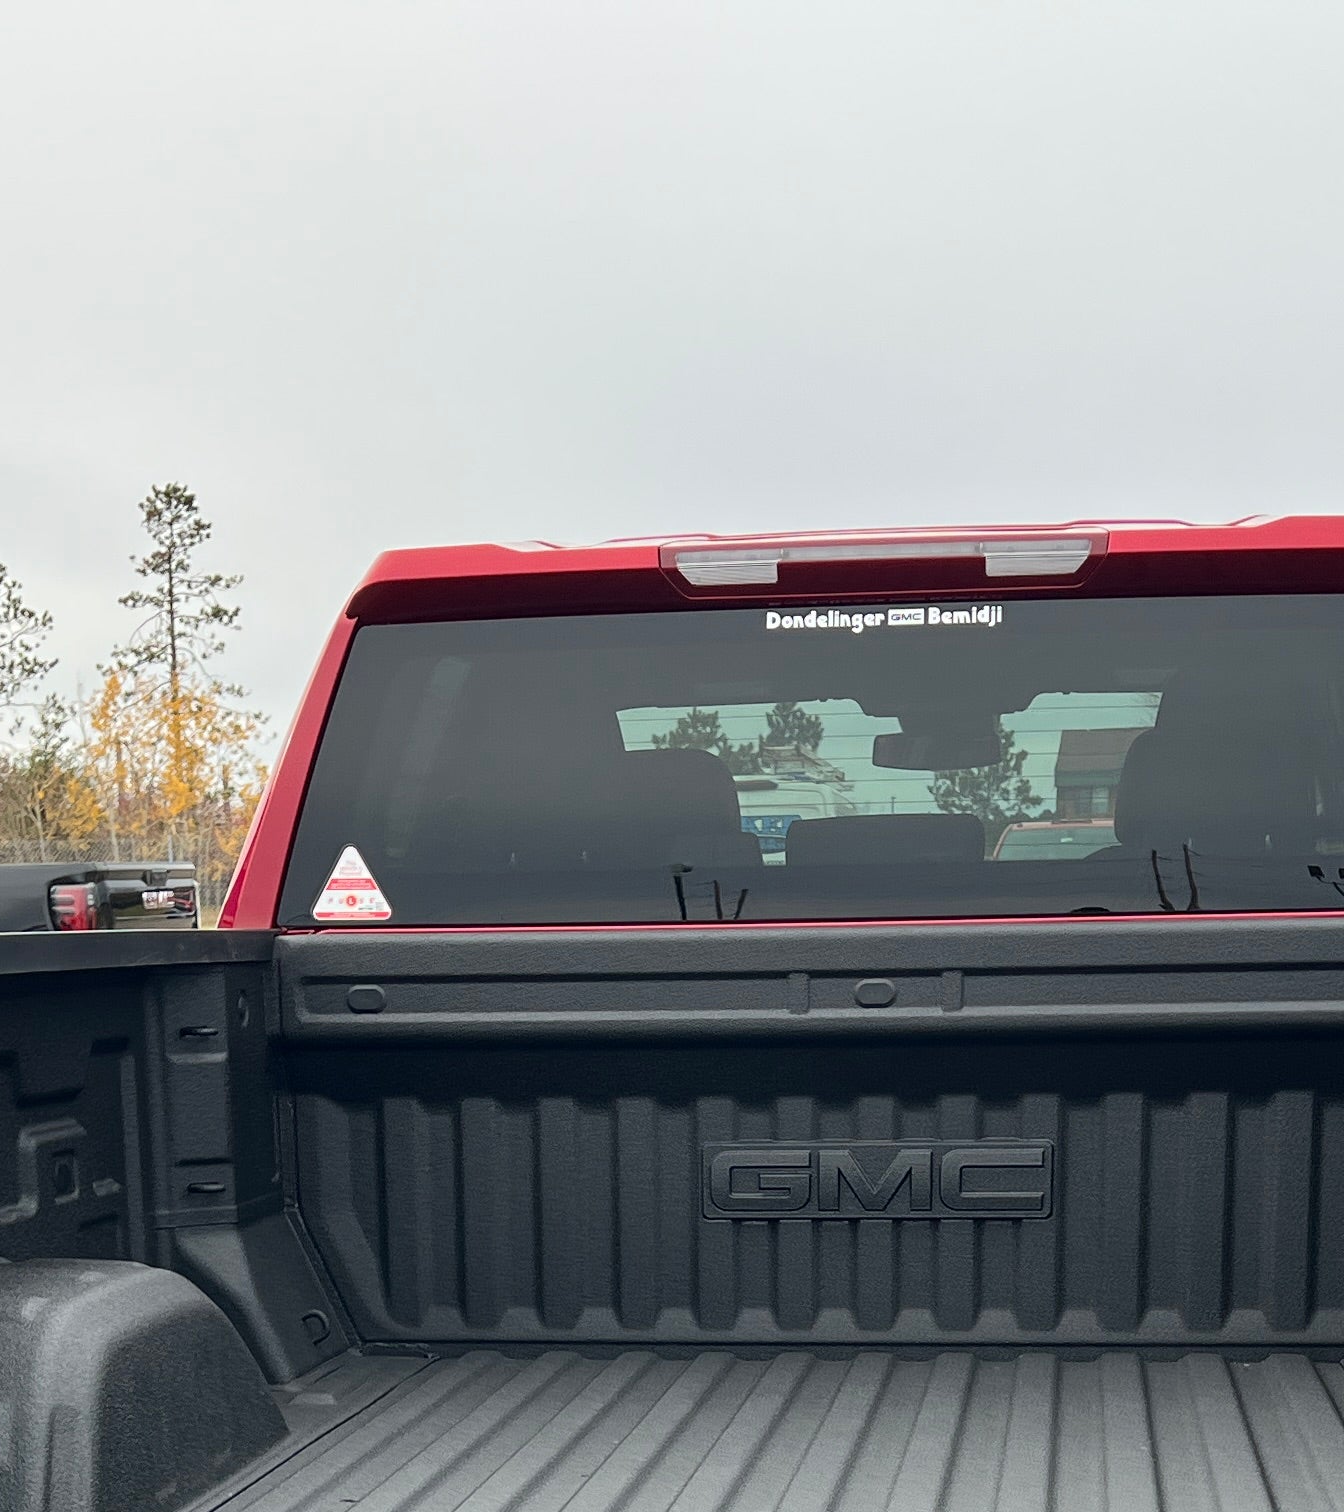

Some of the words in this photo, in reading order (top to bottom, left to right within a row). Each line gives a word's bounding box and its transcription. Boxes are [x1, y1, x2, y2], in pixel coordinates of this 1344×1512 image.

[766, 609, 885, 633] Dondelinger
[889, 611, 923, 622] GMC
[927, 605, 1003, 627] Bemidji
[709, 1147, 1047, 1213] GMC
